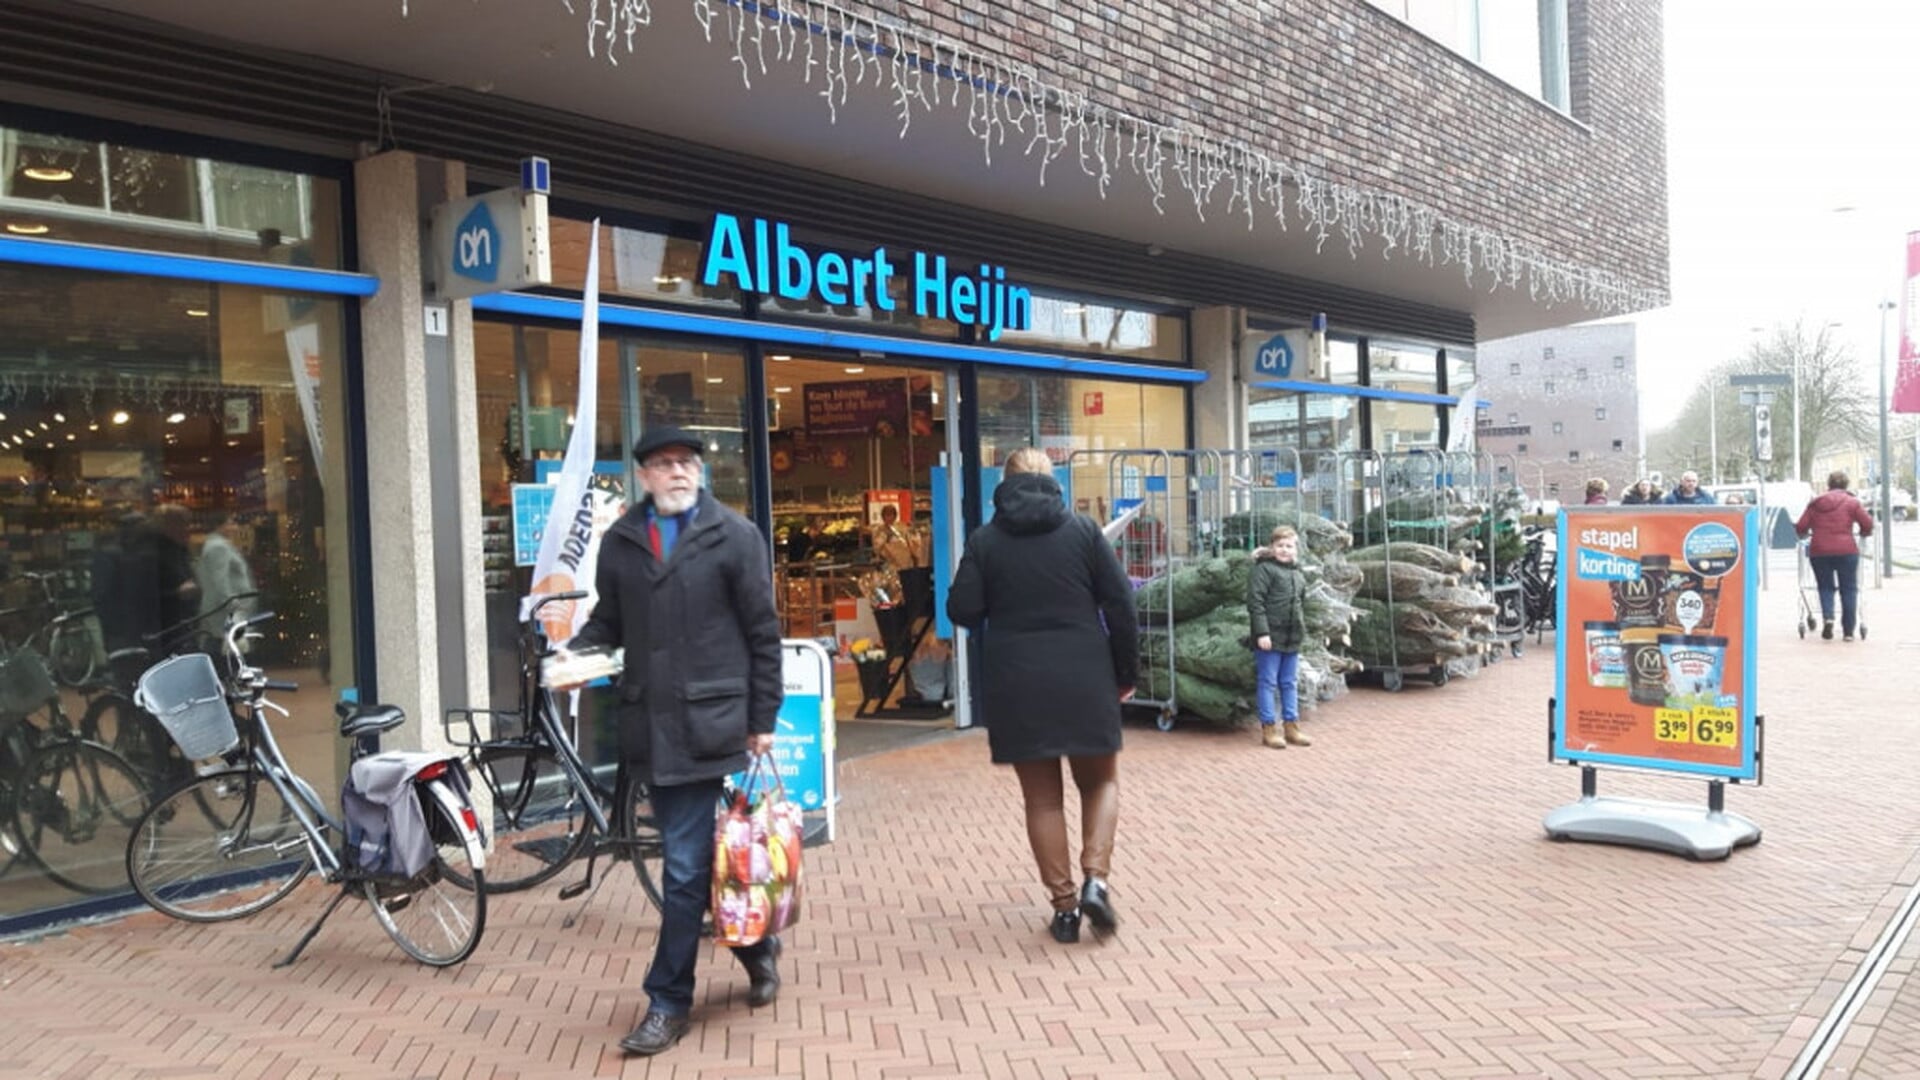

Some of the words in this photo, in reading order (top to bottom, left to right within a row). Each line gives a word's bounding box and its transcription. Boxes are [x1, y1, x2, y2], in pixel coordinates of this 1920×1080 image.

[703, 212, 895, 311] Albert
[916, 251, 1031, 341] Heijn
[431, 310, 439, 332] 1
[1581, 525, 1638, 551] stapel
[1579, 552, 1638, 580] korting
[1627, 580, 1648, 596] M
[1642, 652, 1661, 672] M
[1658, 719, 1688, 740] 3.99
[1697, 719, 1734, 743] 6.99
